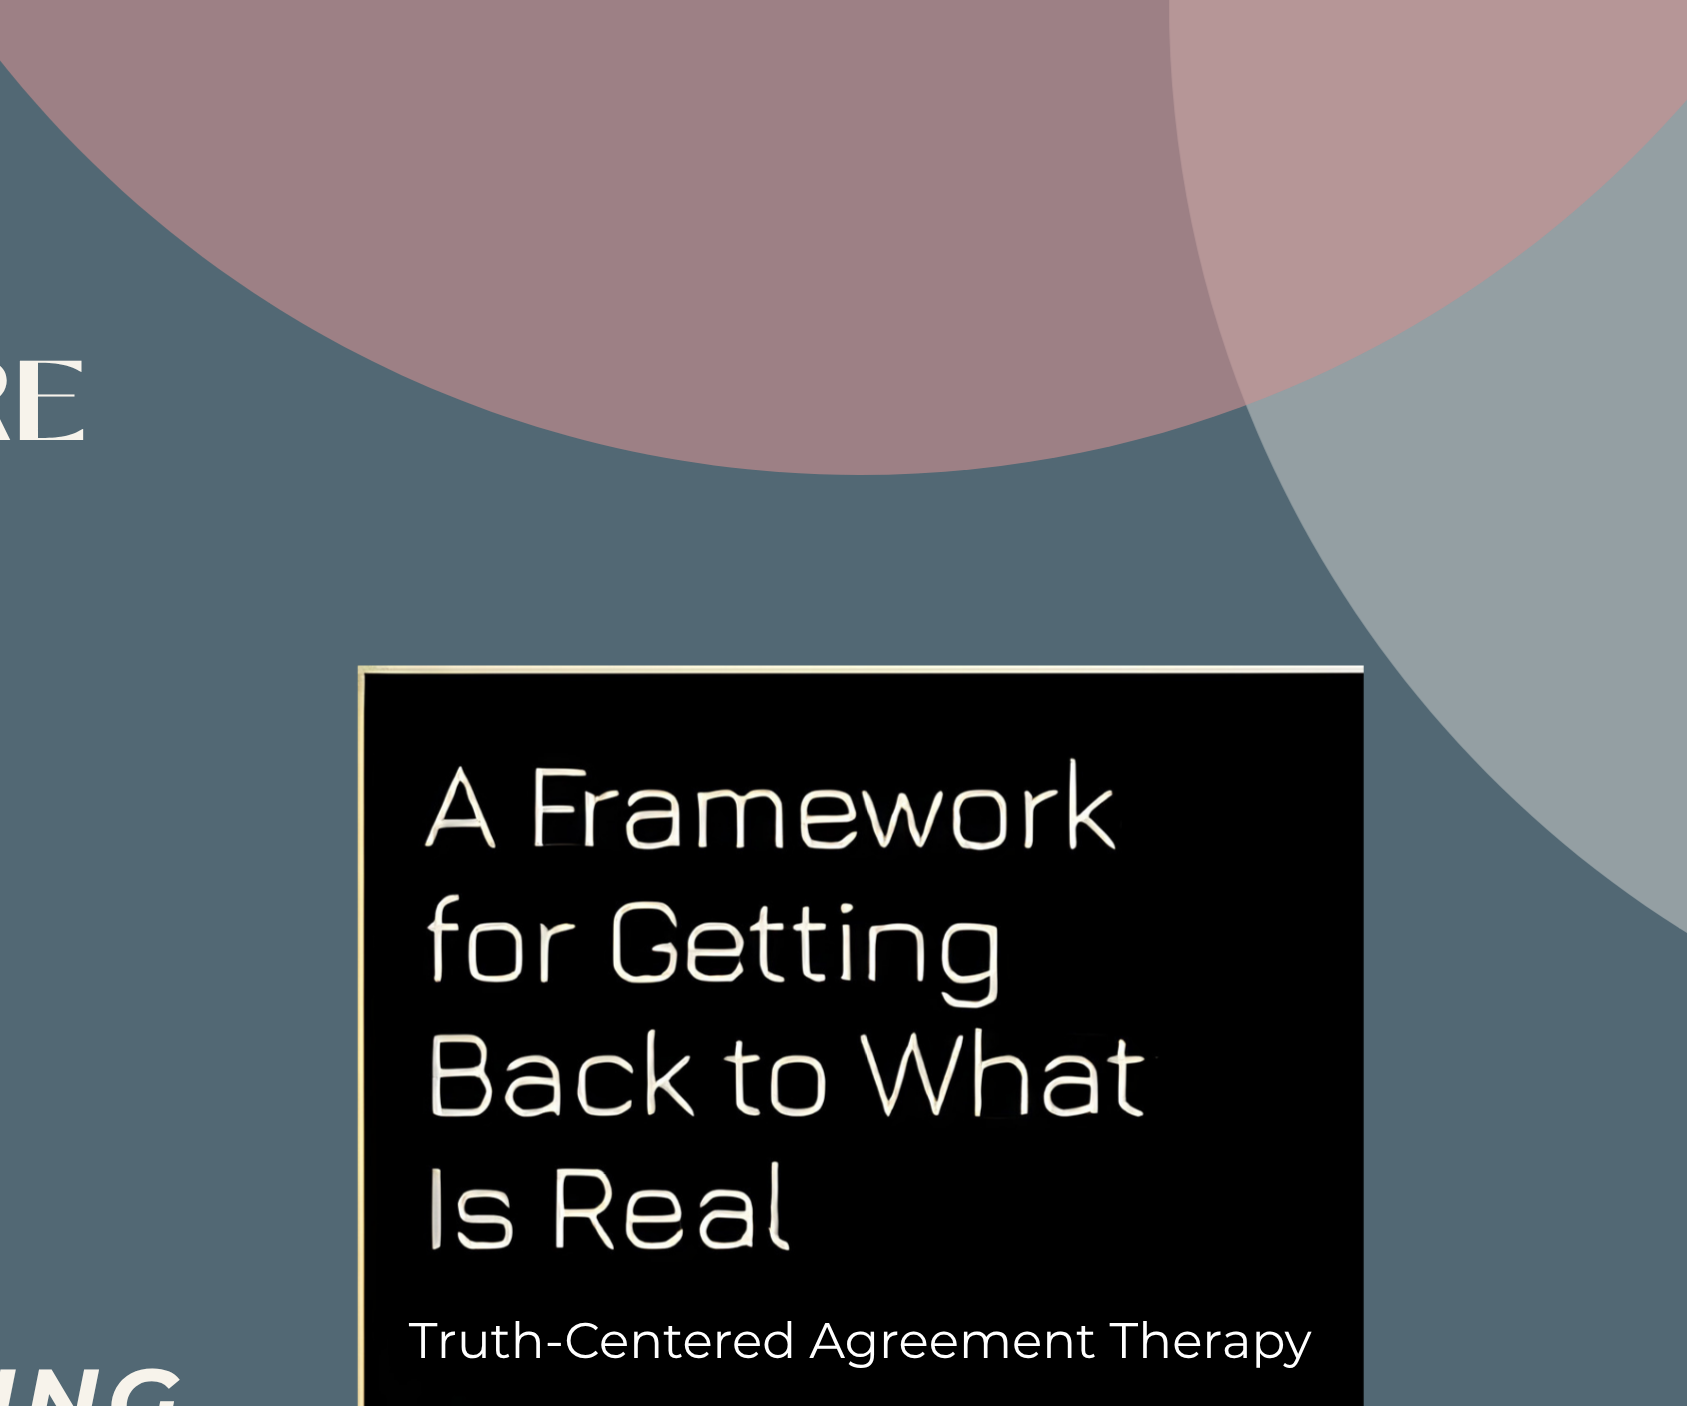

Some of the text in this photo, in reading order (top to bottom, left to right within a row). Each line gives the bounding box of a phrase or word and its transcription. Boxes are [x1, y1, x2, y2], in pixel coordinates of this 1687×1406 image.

[425, 758, 1115, 850] A Framework
[427, 894, 998, 1008] for Getting
[432, 1028, 1144, 1117] Back to What
[432, 1161, 789, 1251] Is Real
[409, 1321, 1311, 1368] Truth-Centered Agreement Therapy
